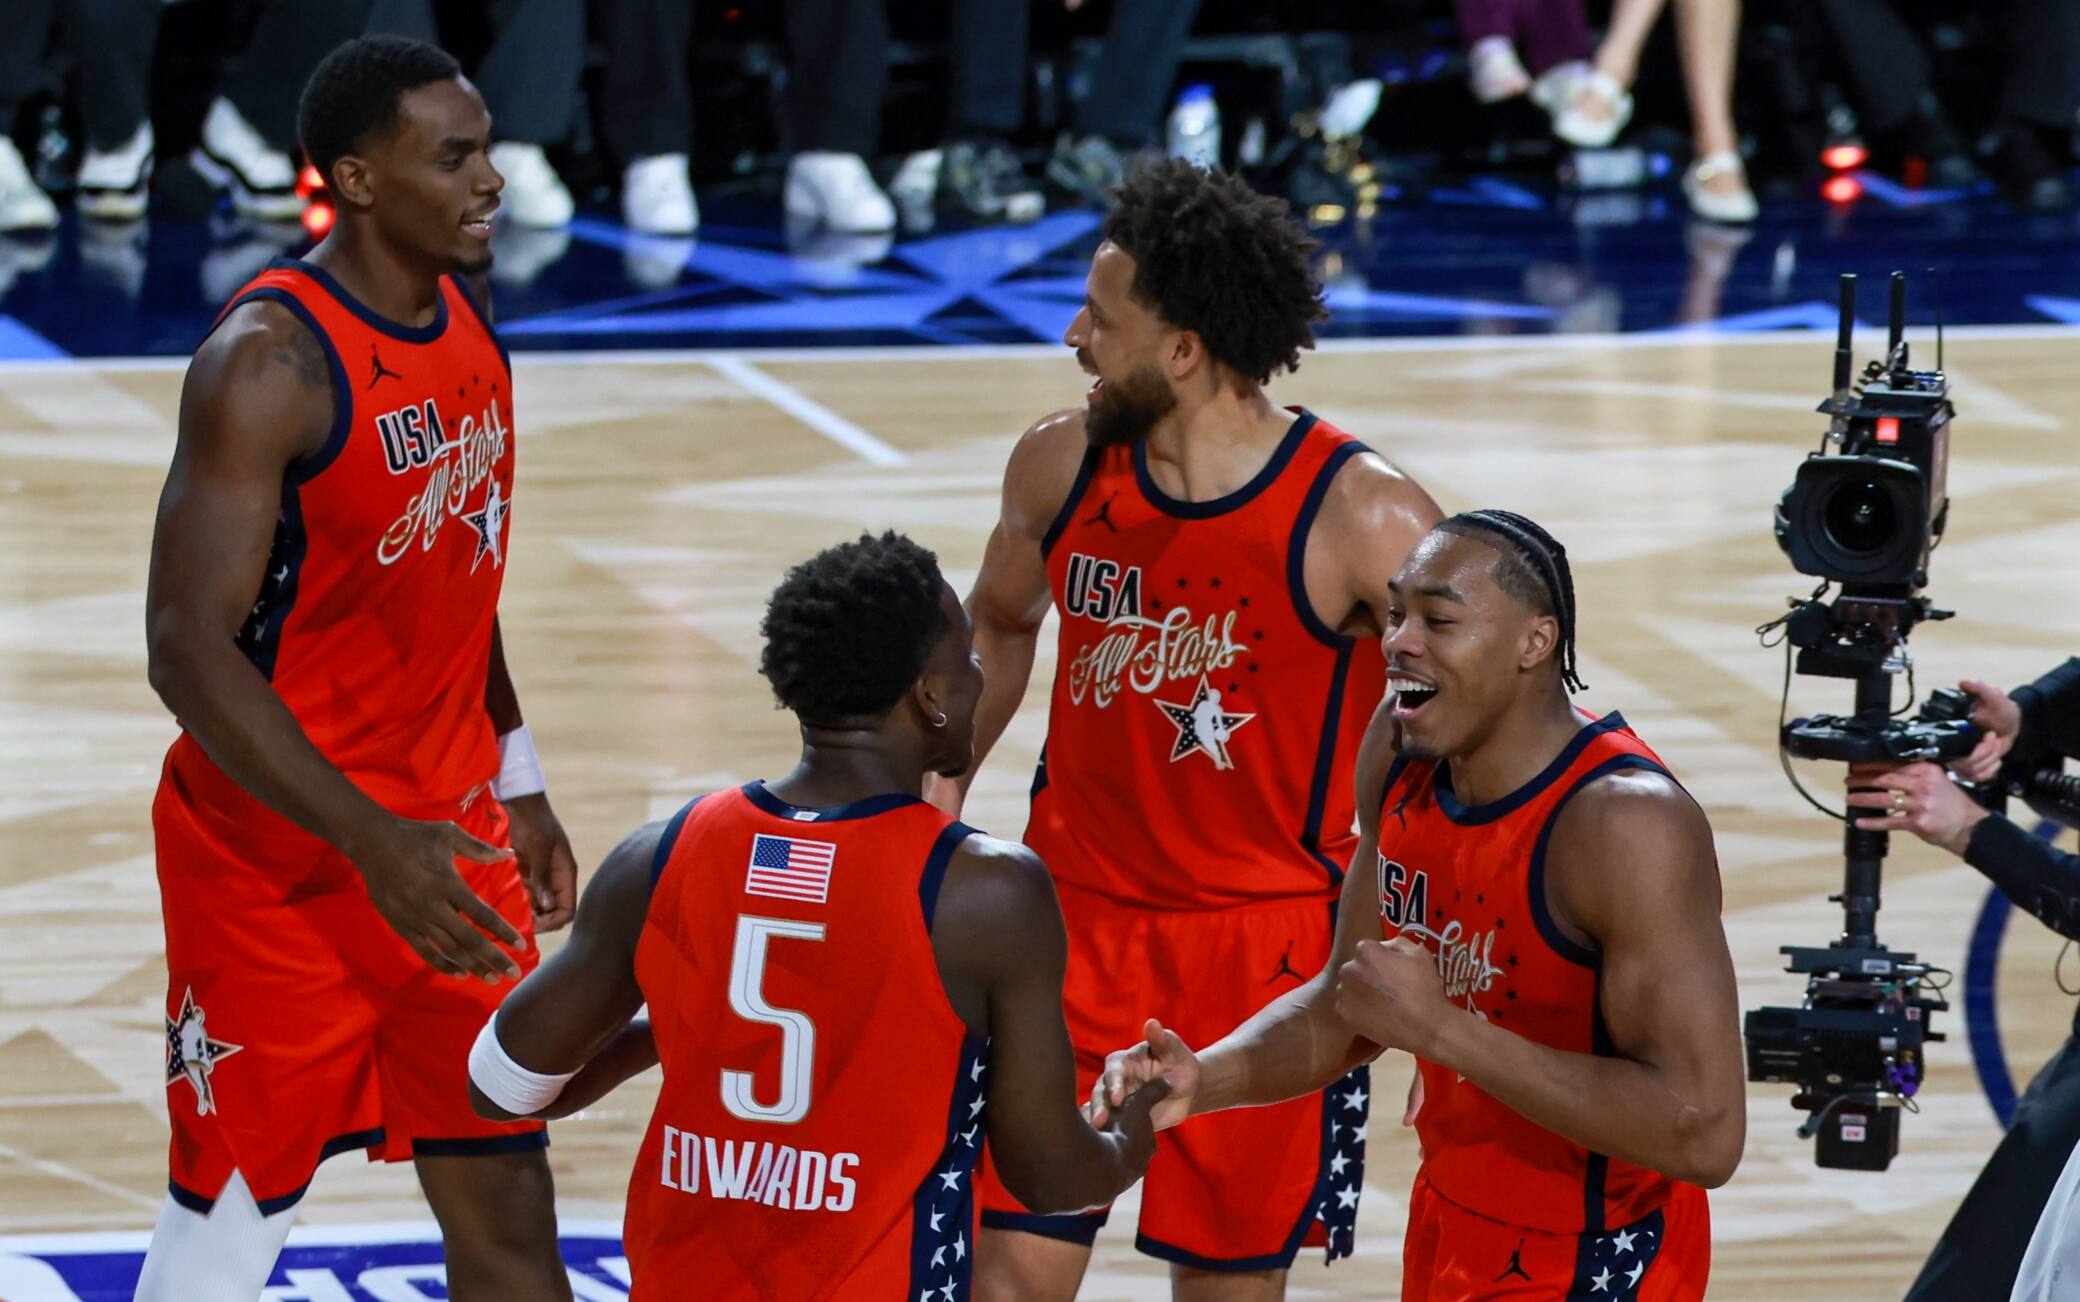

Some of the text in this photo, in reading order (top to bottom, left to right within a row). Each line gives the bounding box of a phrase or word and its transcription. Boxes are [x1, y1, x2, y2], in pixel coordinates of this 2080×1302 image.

[375, 398, 449, 475] USA
[377, 399, 507, 565] All Stars
[1065, 553, 1142, 629] USA
[1070, 606, 1250, 708] All Stars
[721, 914, 826, 1124] 5
[660, 1124, 860, 1213] EDWARDS
